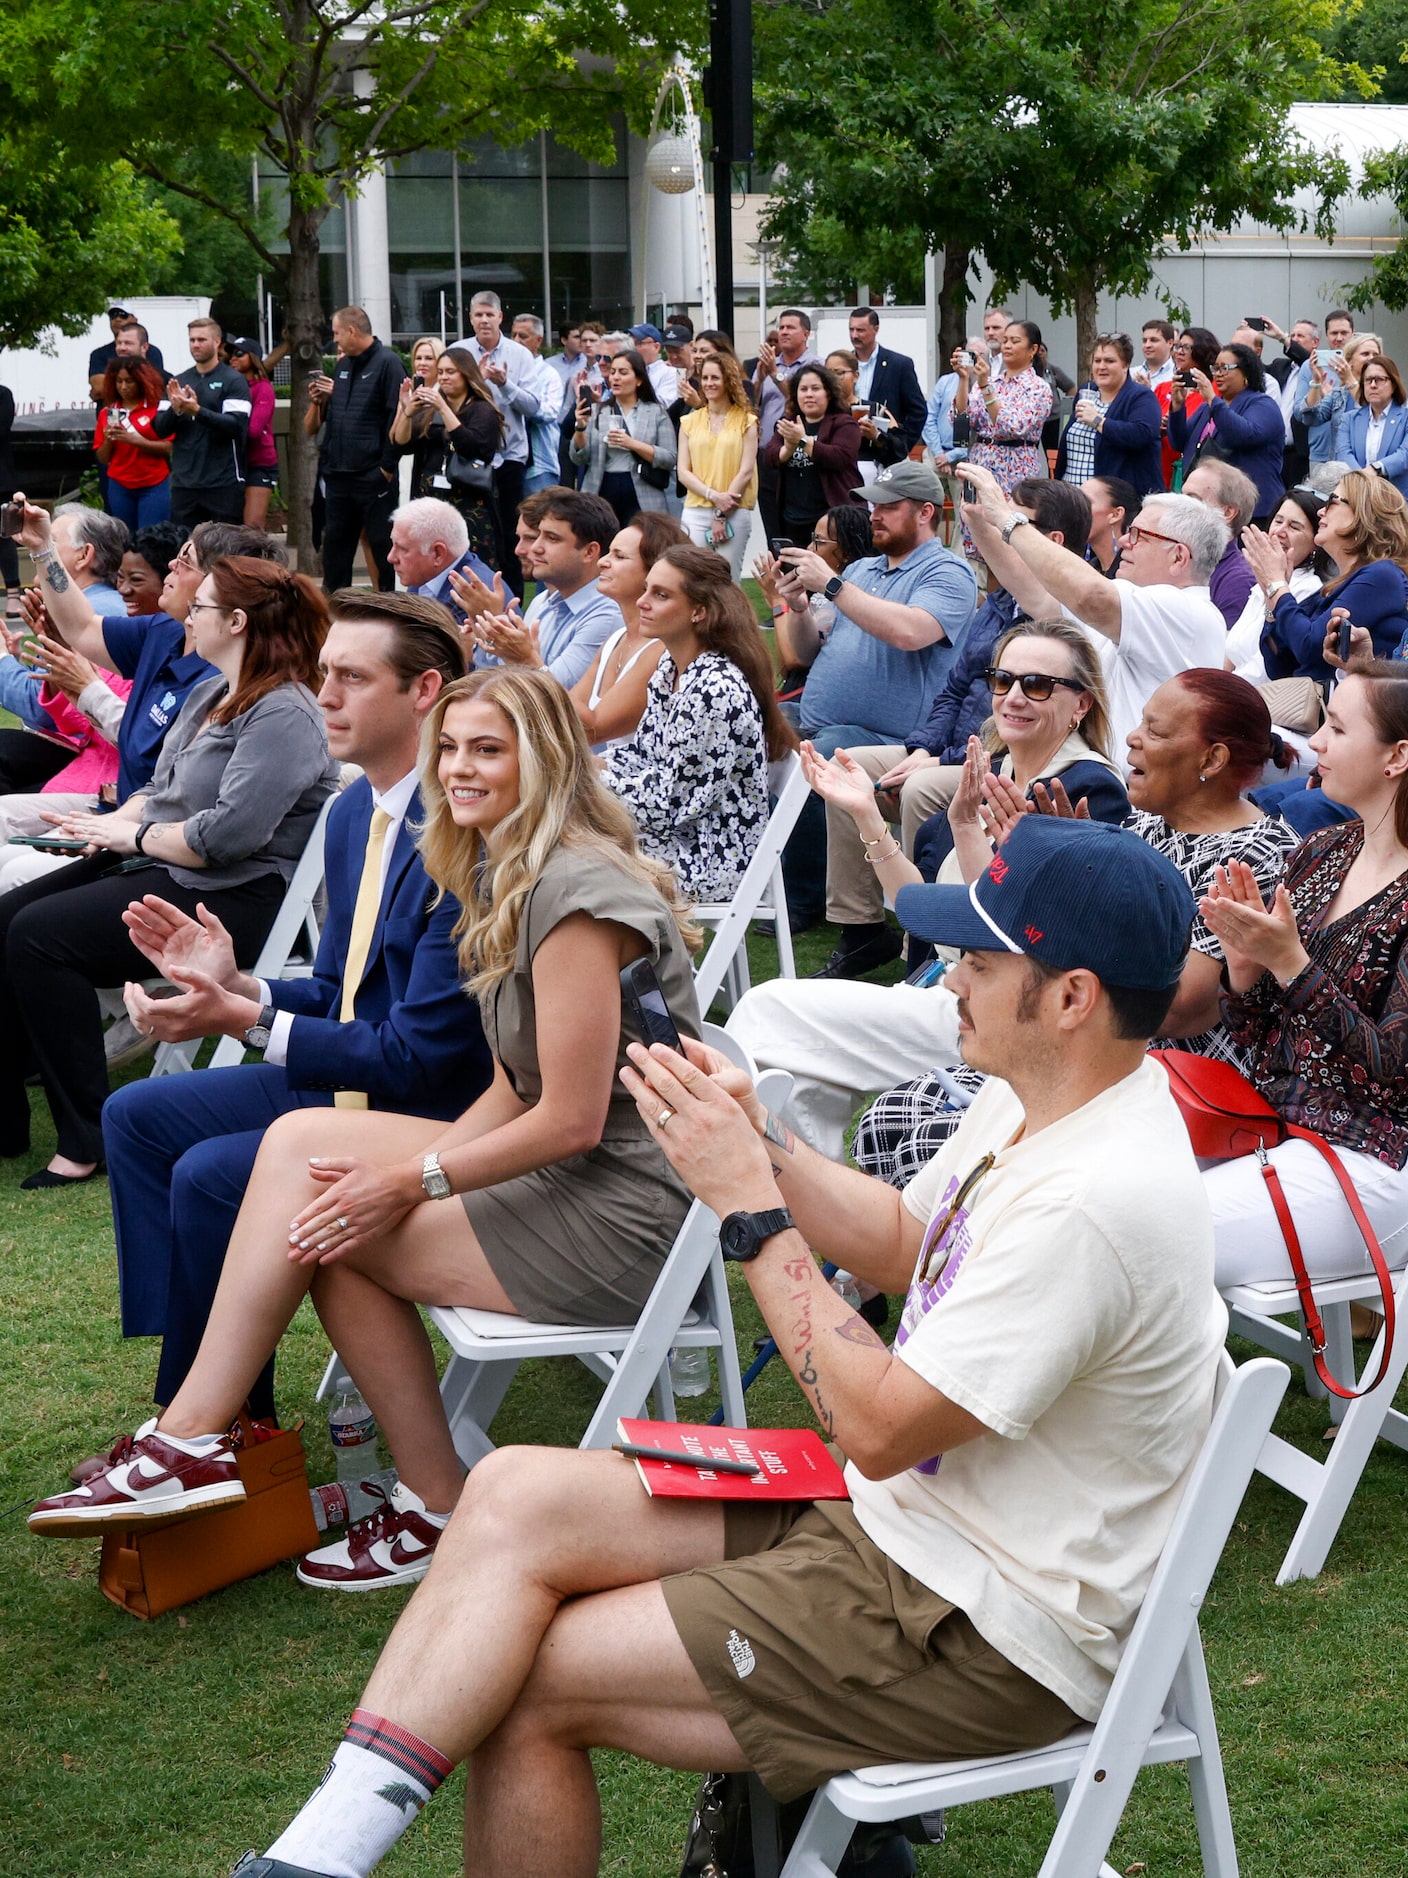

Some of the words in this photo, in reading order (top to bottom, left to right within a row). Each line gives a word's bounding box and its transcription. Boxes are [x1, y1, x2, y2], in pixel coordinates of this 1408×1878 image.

[680, 1435, 707, 1457] NOTE
[709, 1446, 732, 1461] THE
[728, 1438, 770, 1484] IMORTANT
[758, 1450, 788, 1474] STUFF
[726, 1640, 741, 1664] FACE
[729, 1629, 748, 1663] NORTH
[741, 1638, 754, 1658] THE
